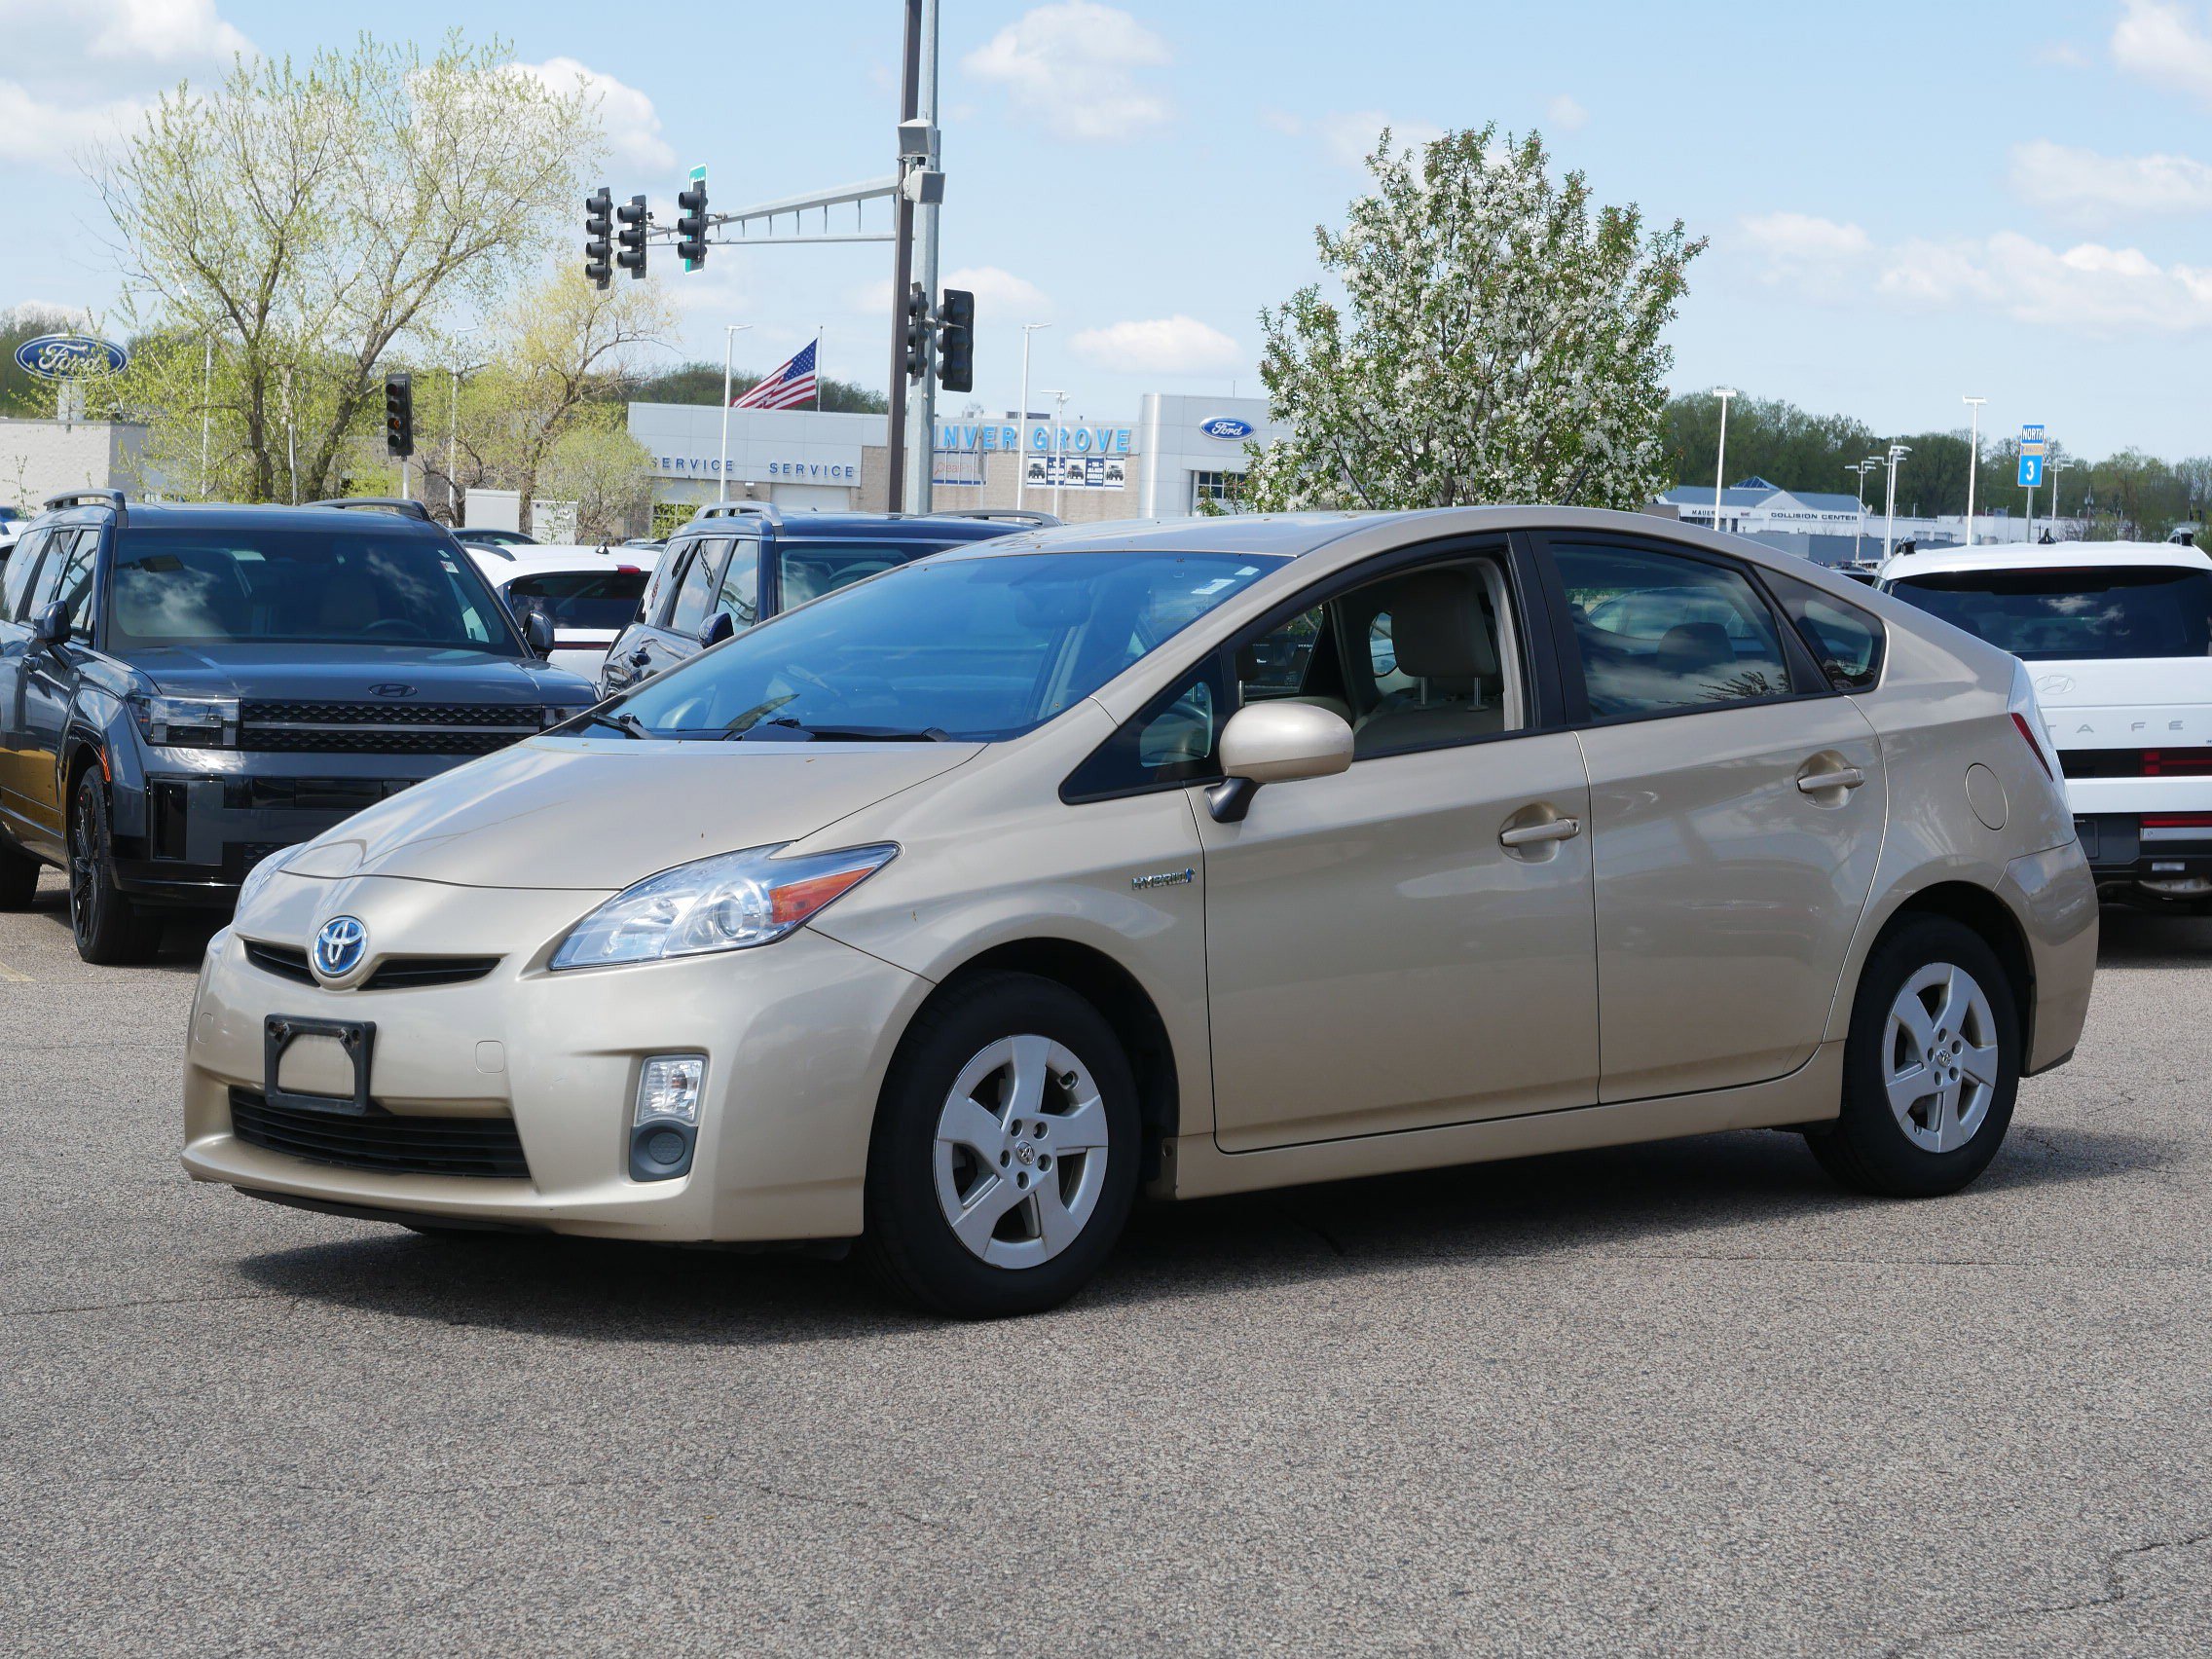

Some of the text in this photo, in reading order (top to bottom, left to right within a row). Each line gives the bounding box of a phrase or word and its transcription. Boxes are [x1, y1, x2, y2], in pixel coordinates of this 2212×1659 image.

[1211, 422, 1243, 436] Ford
[2022, 427, 2044, 441] NORTH
[1032, 426, 1131, 453] GROVE
[649, 458, 734, 472] SERVICE
[769, 462, 854, 477] SERVICE
[2026, 461, 2035, 481] 3
[2130, 719, 2184, 731] FE
[1131, 872, 1186, 890] HYBRID
